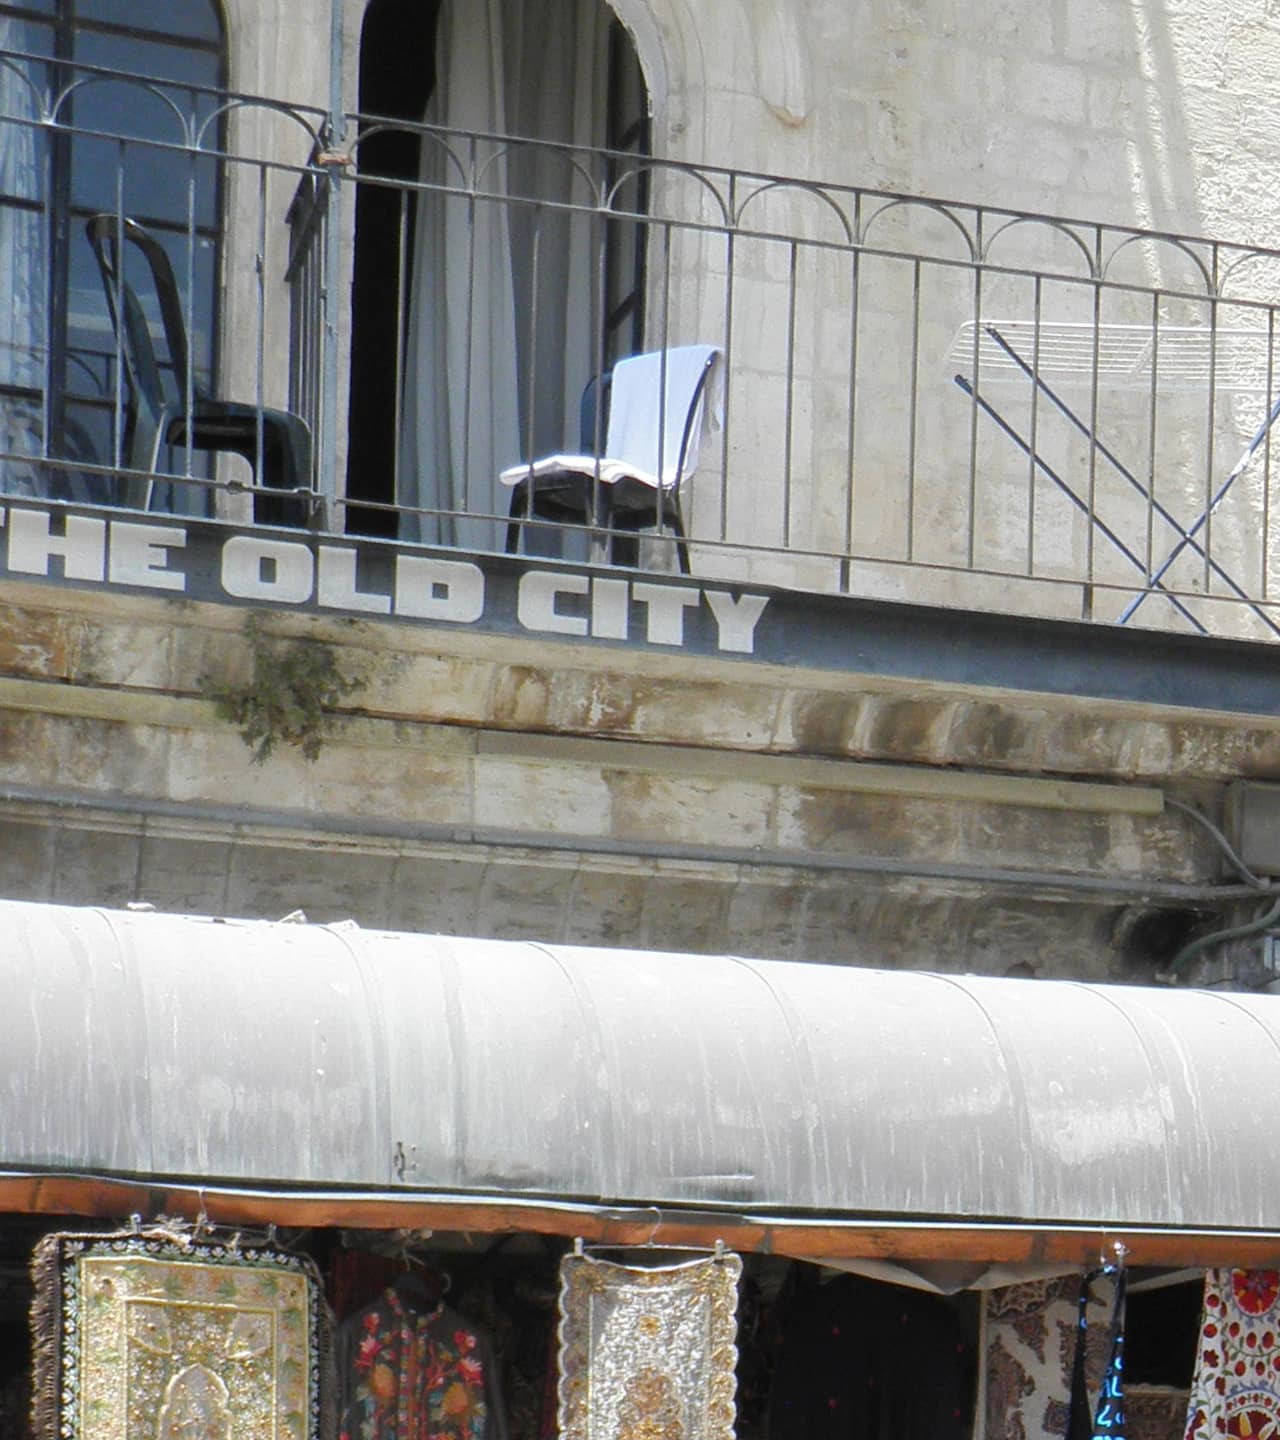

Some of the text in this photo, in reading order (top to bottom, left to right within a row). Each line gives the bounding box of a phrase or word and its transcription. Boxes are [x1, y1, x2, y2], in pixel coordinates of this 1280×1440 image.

[0, 507, 770, 655] HE OLD CITY
